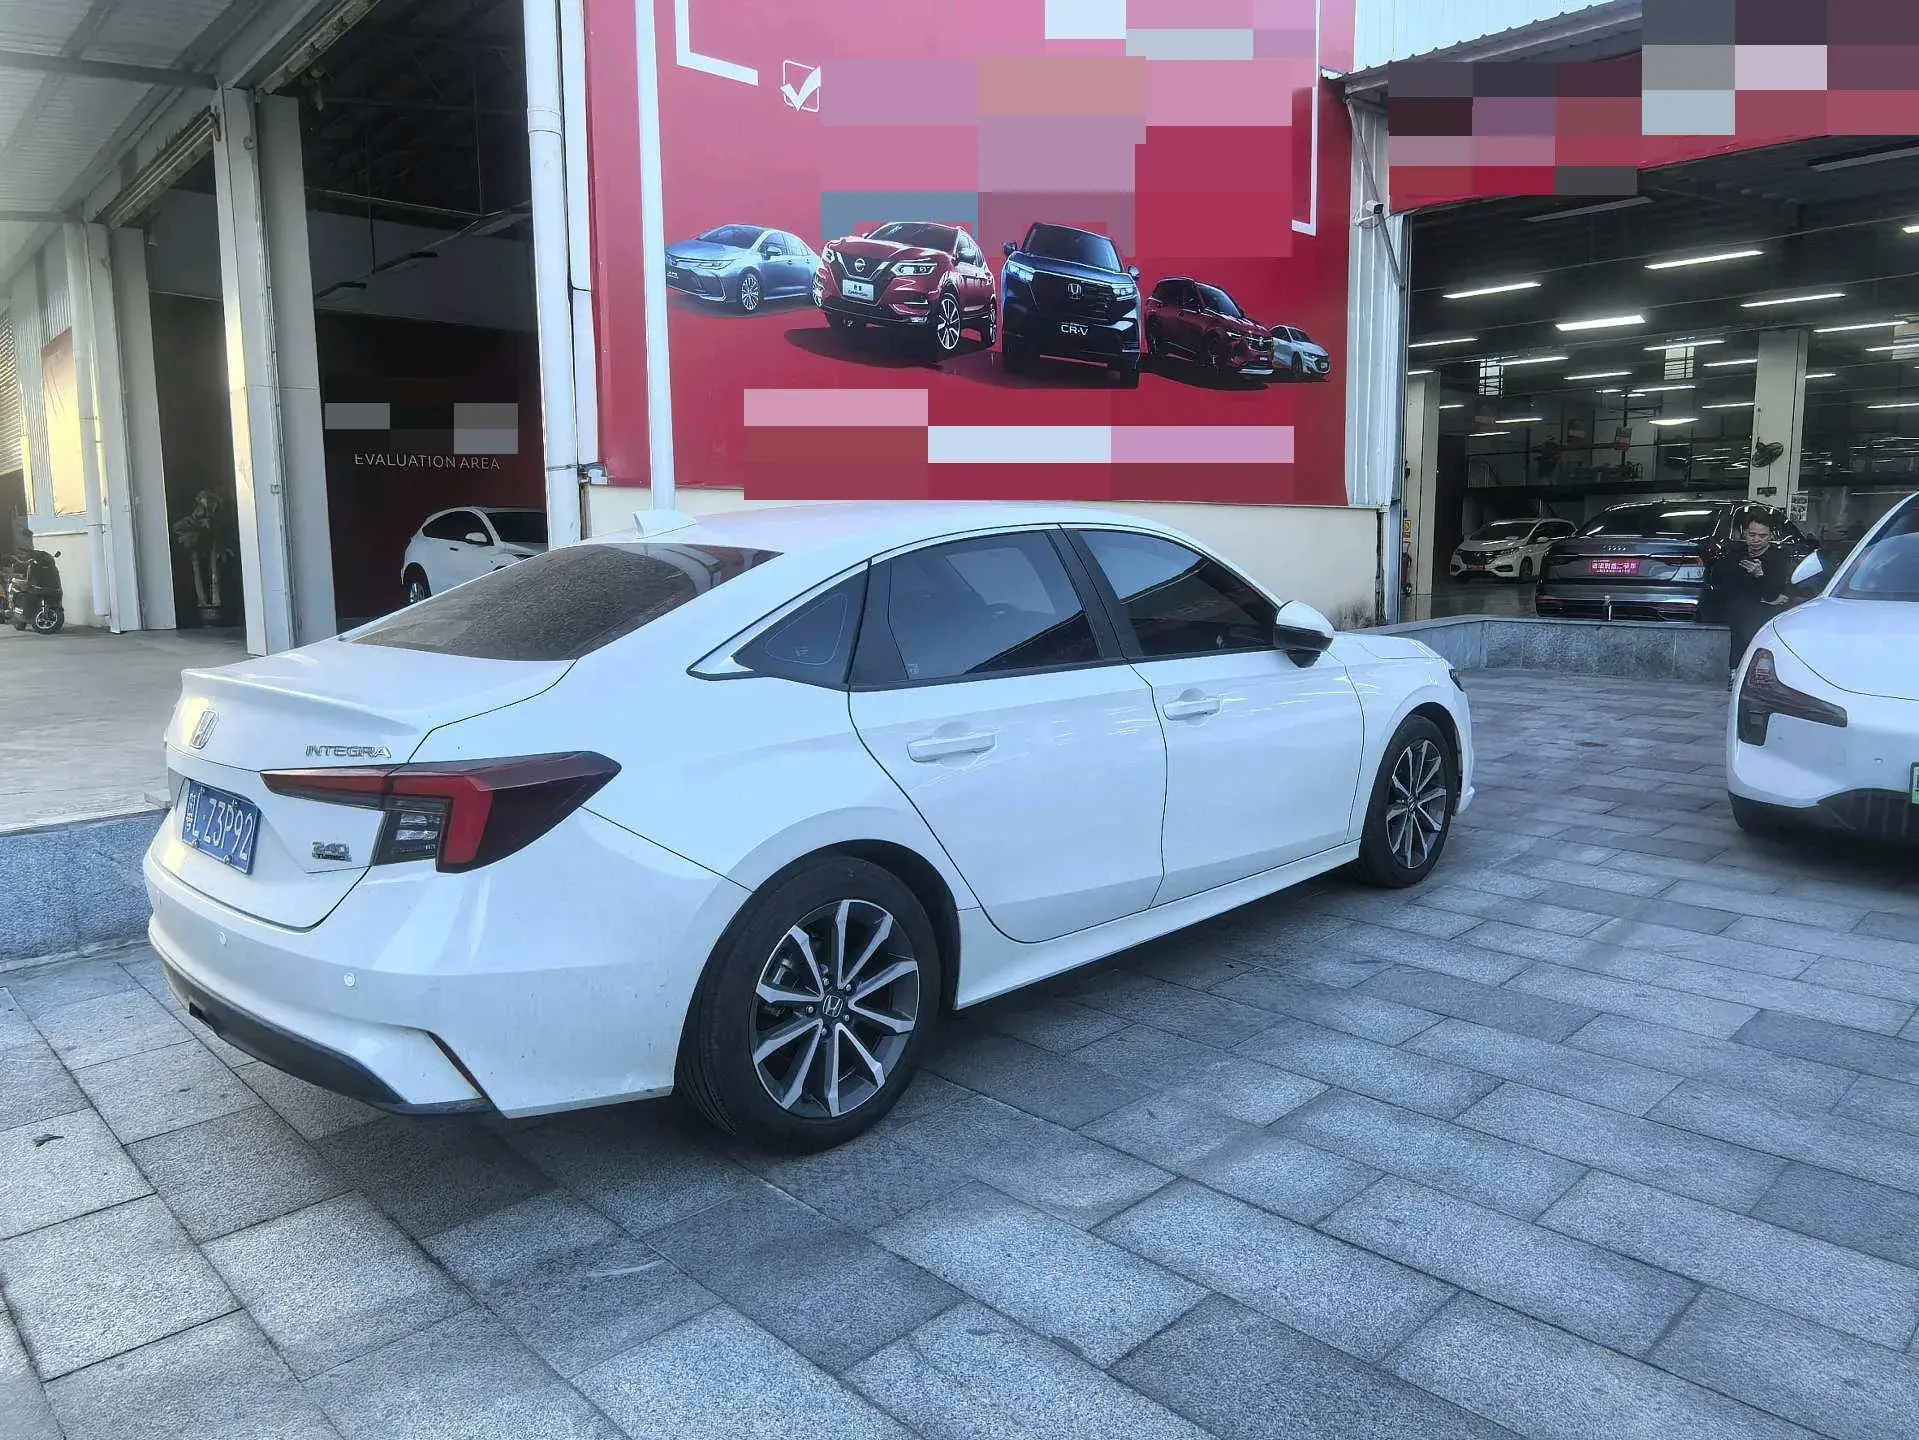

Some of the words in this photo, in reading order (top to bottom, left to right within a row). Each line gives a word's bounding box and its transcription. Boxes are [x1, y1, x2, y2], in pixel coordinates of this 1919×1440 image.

[354, 453, 456, 468] EVALUATION
[459, 457, 500, 470] AREA
[305, 745, 392, 759] INTEGRA
